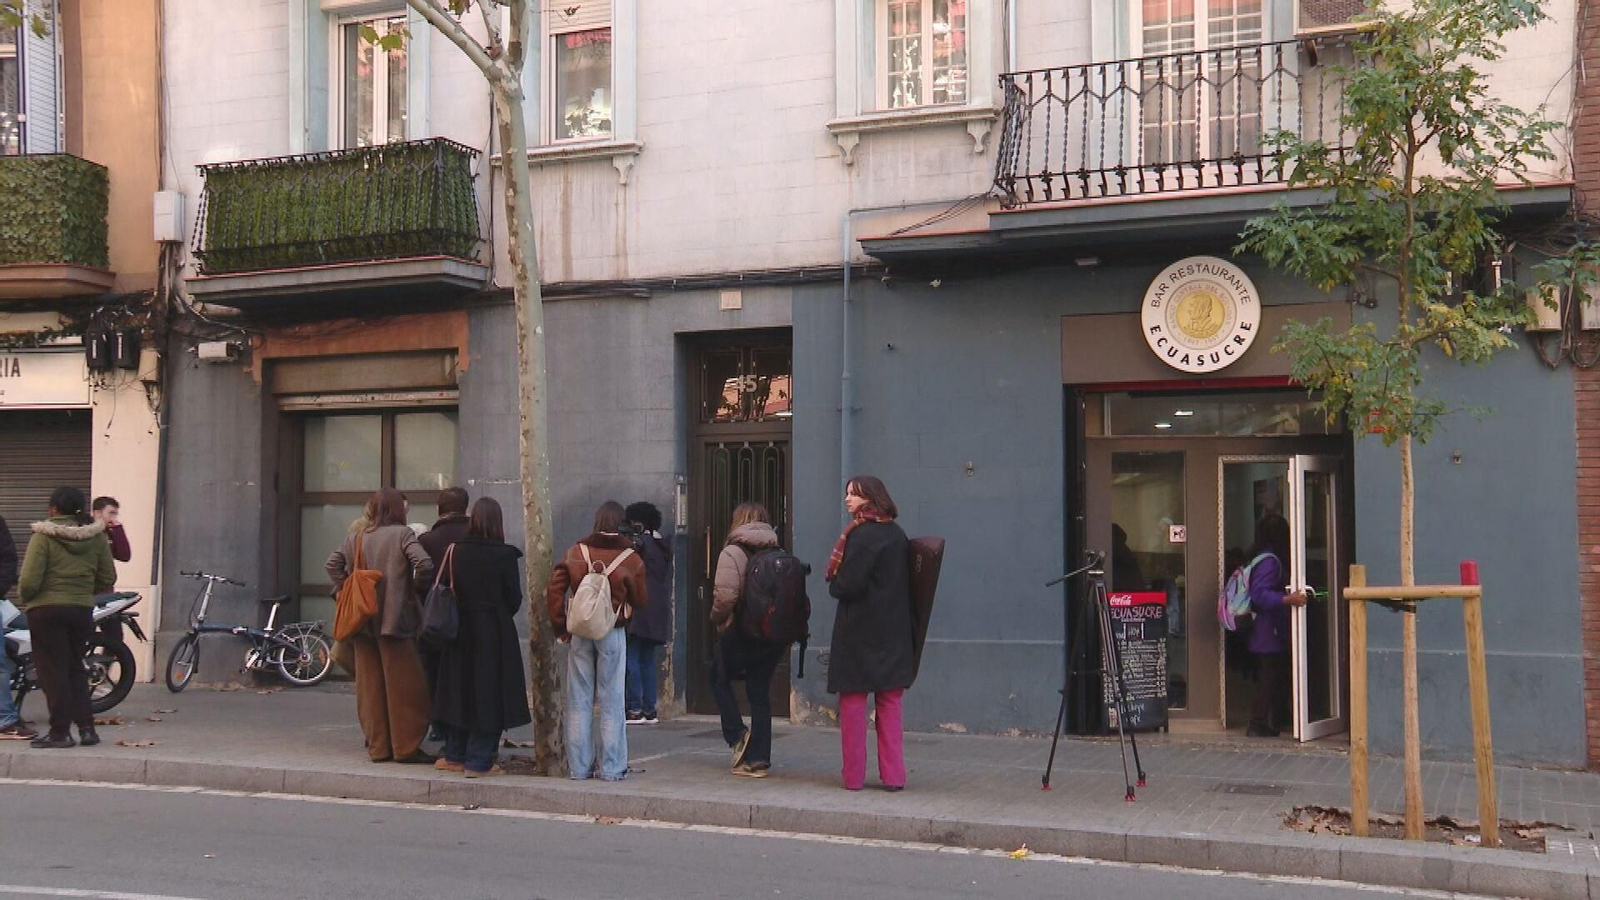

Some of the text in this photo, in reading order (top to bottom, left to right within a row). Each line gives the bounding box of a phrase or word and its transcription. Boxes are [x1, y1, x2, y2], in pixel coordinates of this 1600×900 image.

[1151, 263, 1252, 308] BAR RESTAURANTE
[1150, 321, 1252, 366] ECUASUCRE
[735, 374, 758, 393] 45
[1110, 606, 1163, 619] ECUASUCRE
